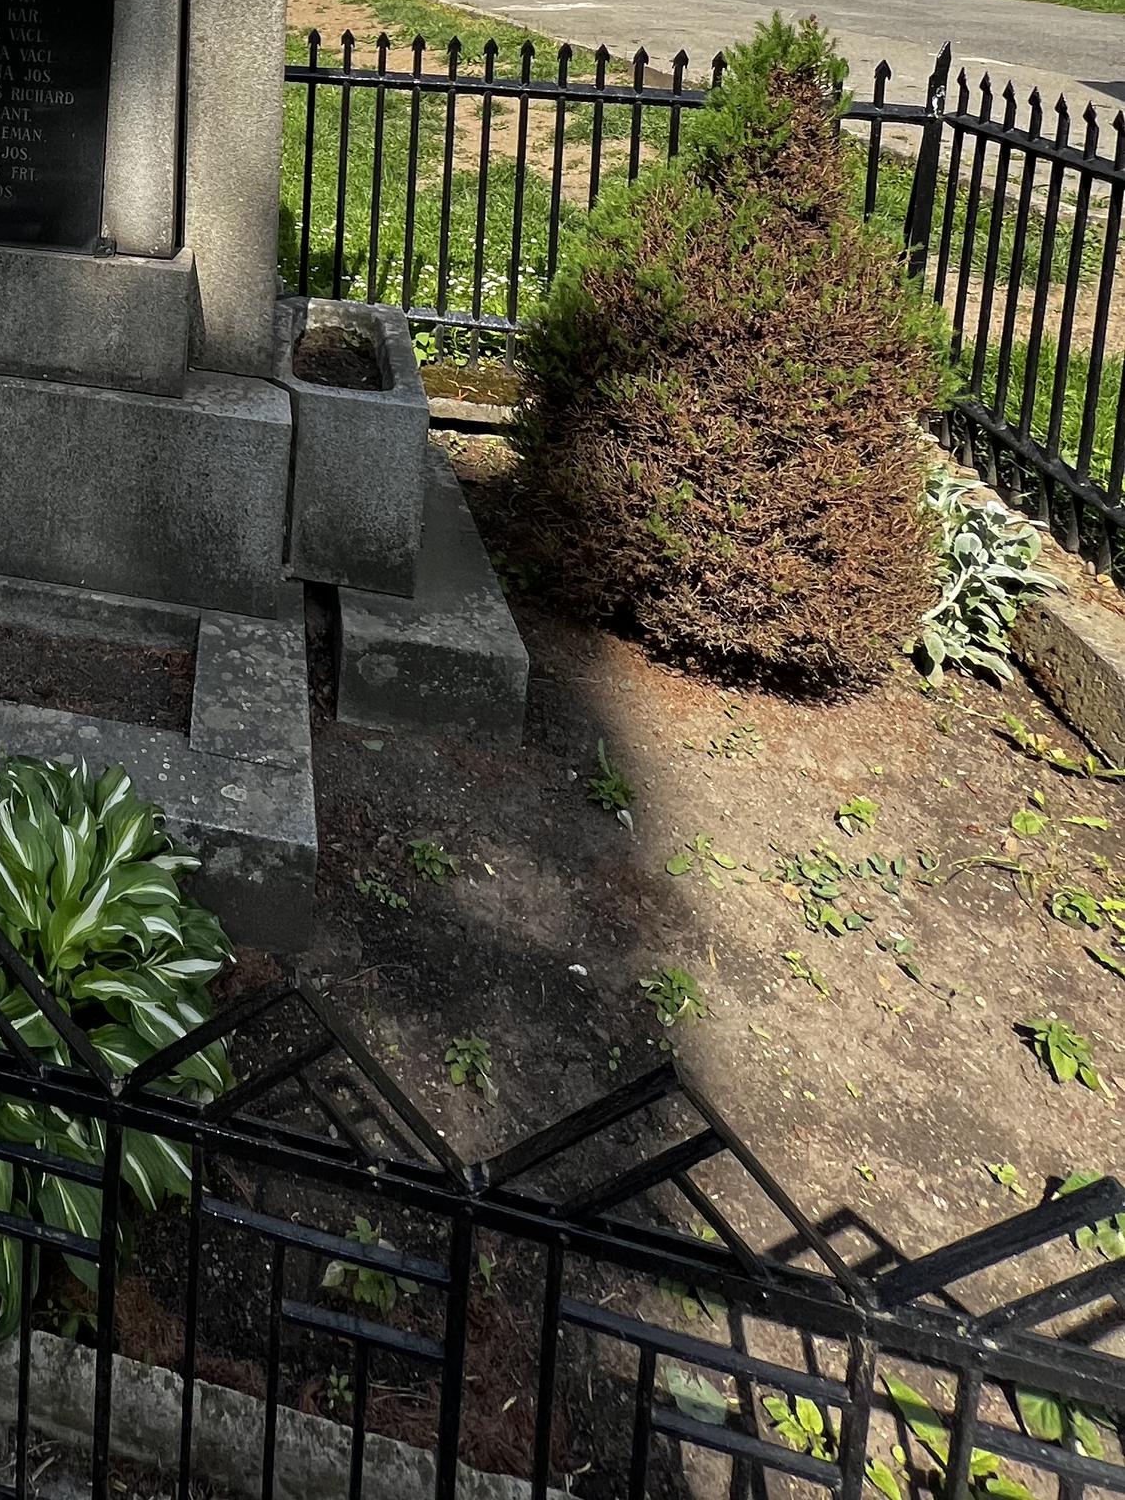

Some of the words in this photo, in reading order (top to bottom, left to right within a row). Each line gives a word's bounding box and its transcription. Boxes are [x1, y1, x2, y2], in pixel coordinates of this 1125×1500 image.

[11, 87, 75, 105] RICHARD
[1, 106, 32, 122] ANT.
[1, 126, 47, 143] EMAN.
